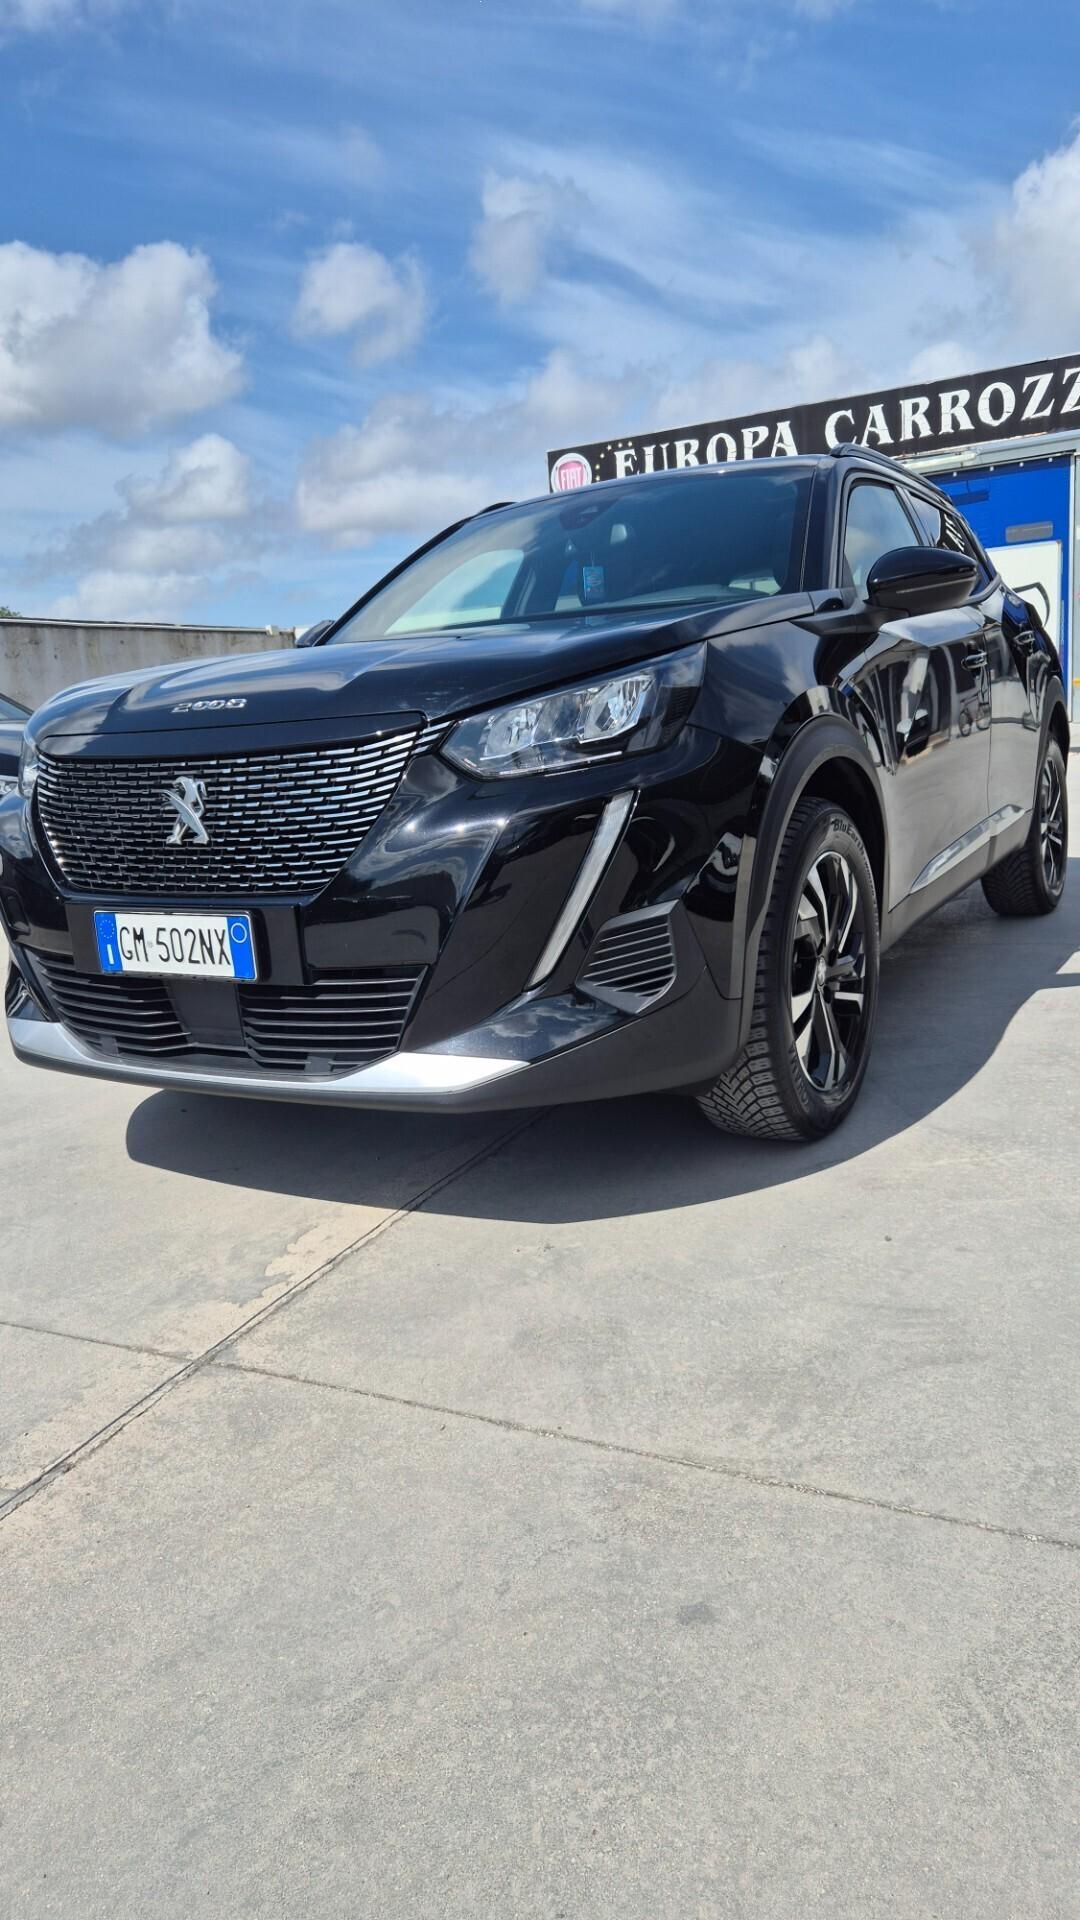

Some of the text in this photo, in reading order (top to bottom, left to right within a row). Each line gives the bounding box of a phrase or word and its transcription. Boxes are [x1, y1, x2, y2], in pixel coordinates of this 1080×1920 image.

[614, 367, 1080, 479] EUROPA CARROZZ
[560, 466, 583, 491] FIAT
[171, 698, 247, 713] 2008
